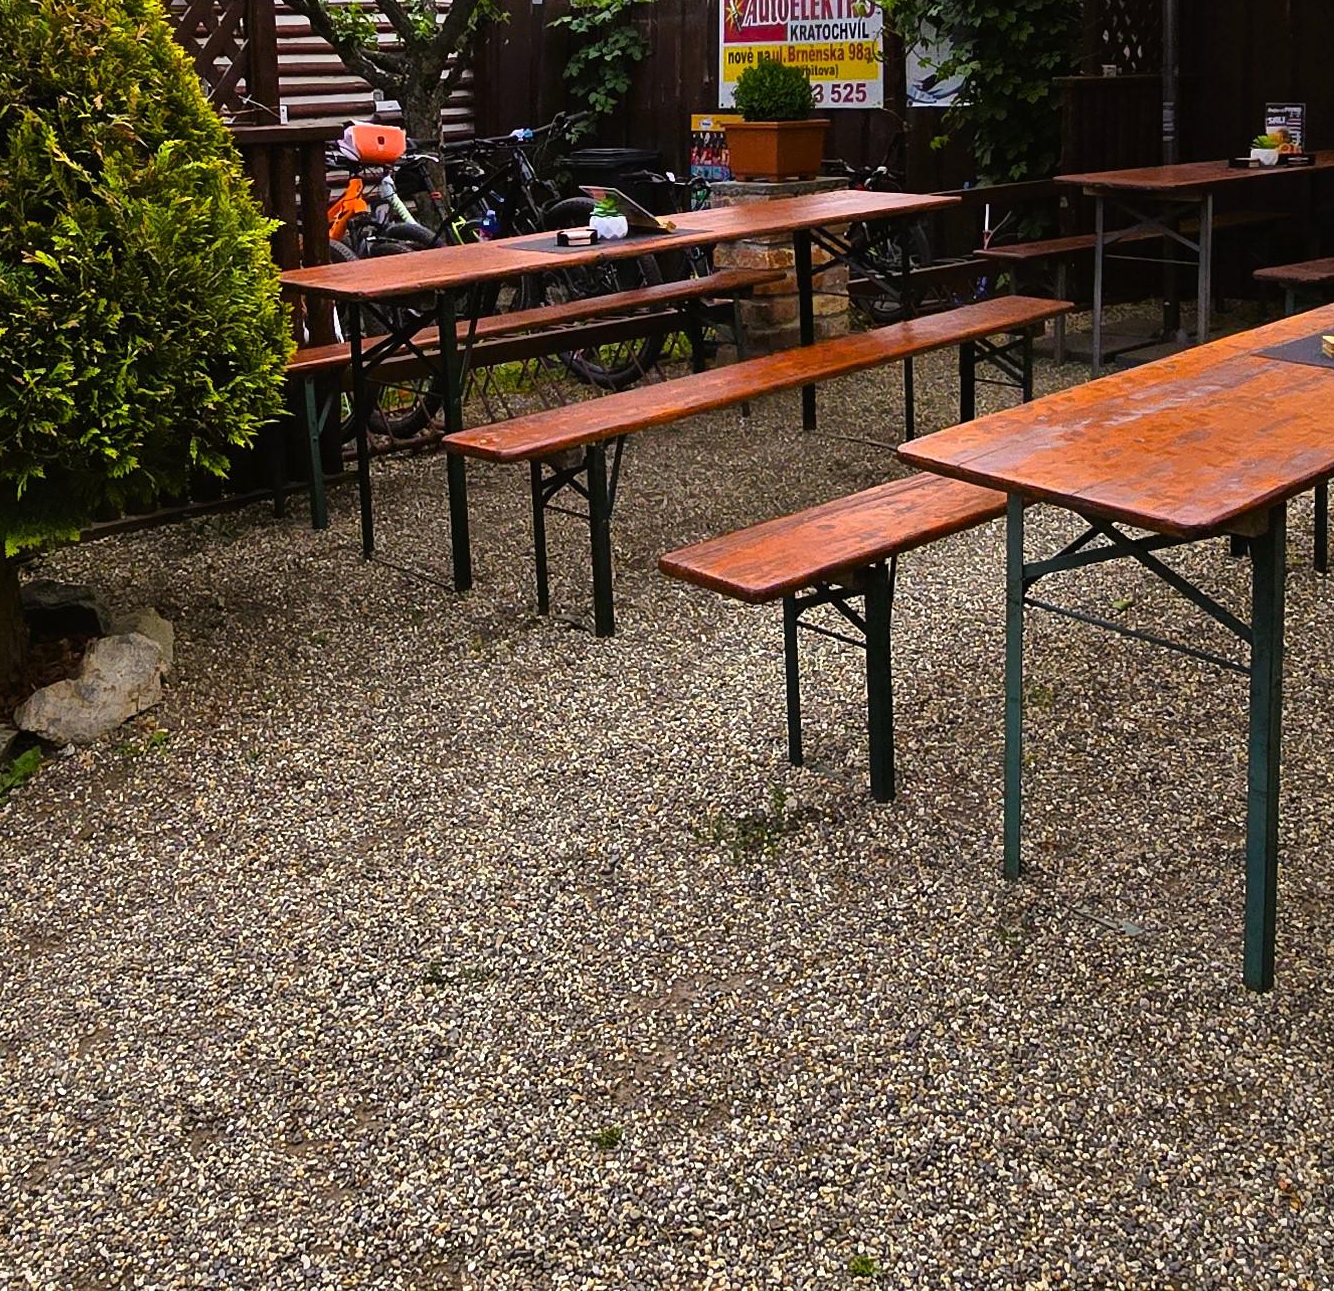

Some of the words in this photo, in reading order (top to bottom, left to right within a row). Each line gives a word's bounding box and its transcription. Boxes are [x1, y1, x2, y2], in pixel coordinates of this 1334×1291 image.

[790, 21, 869, 41] KRATOCHVÍL
[788, 43, 845, 62] Brněnská
[831, 82, 867, 103] 525
